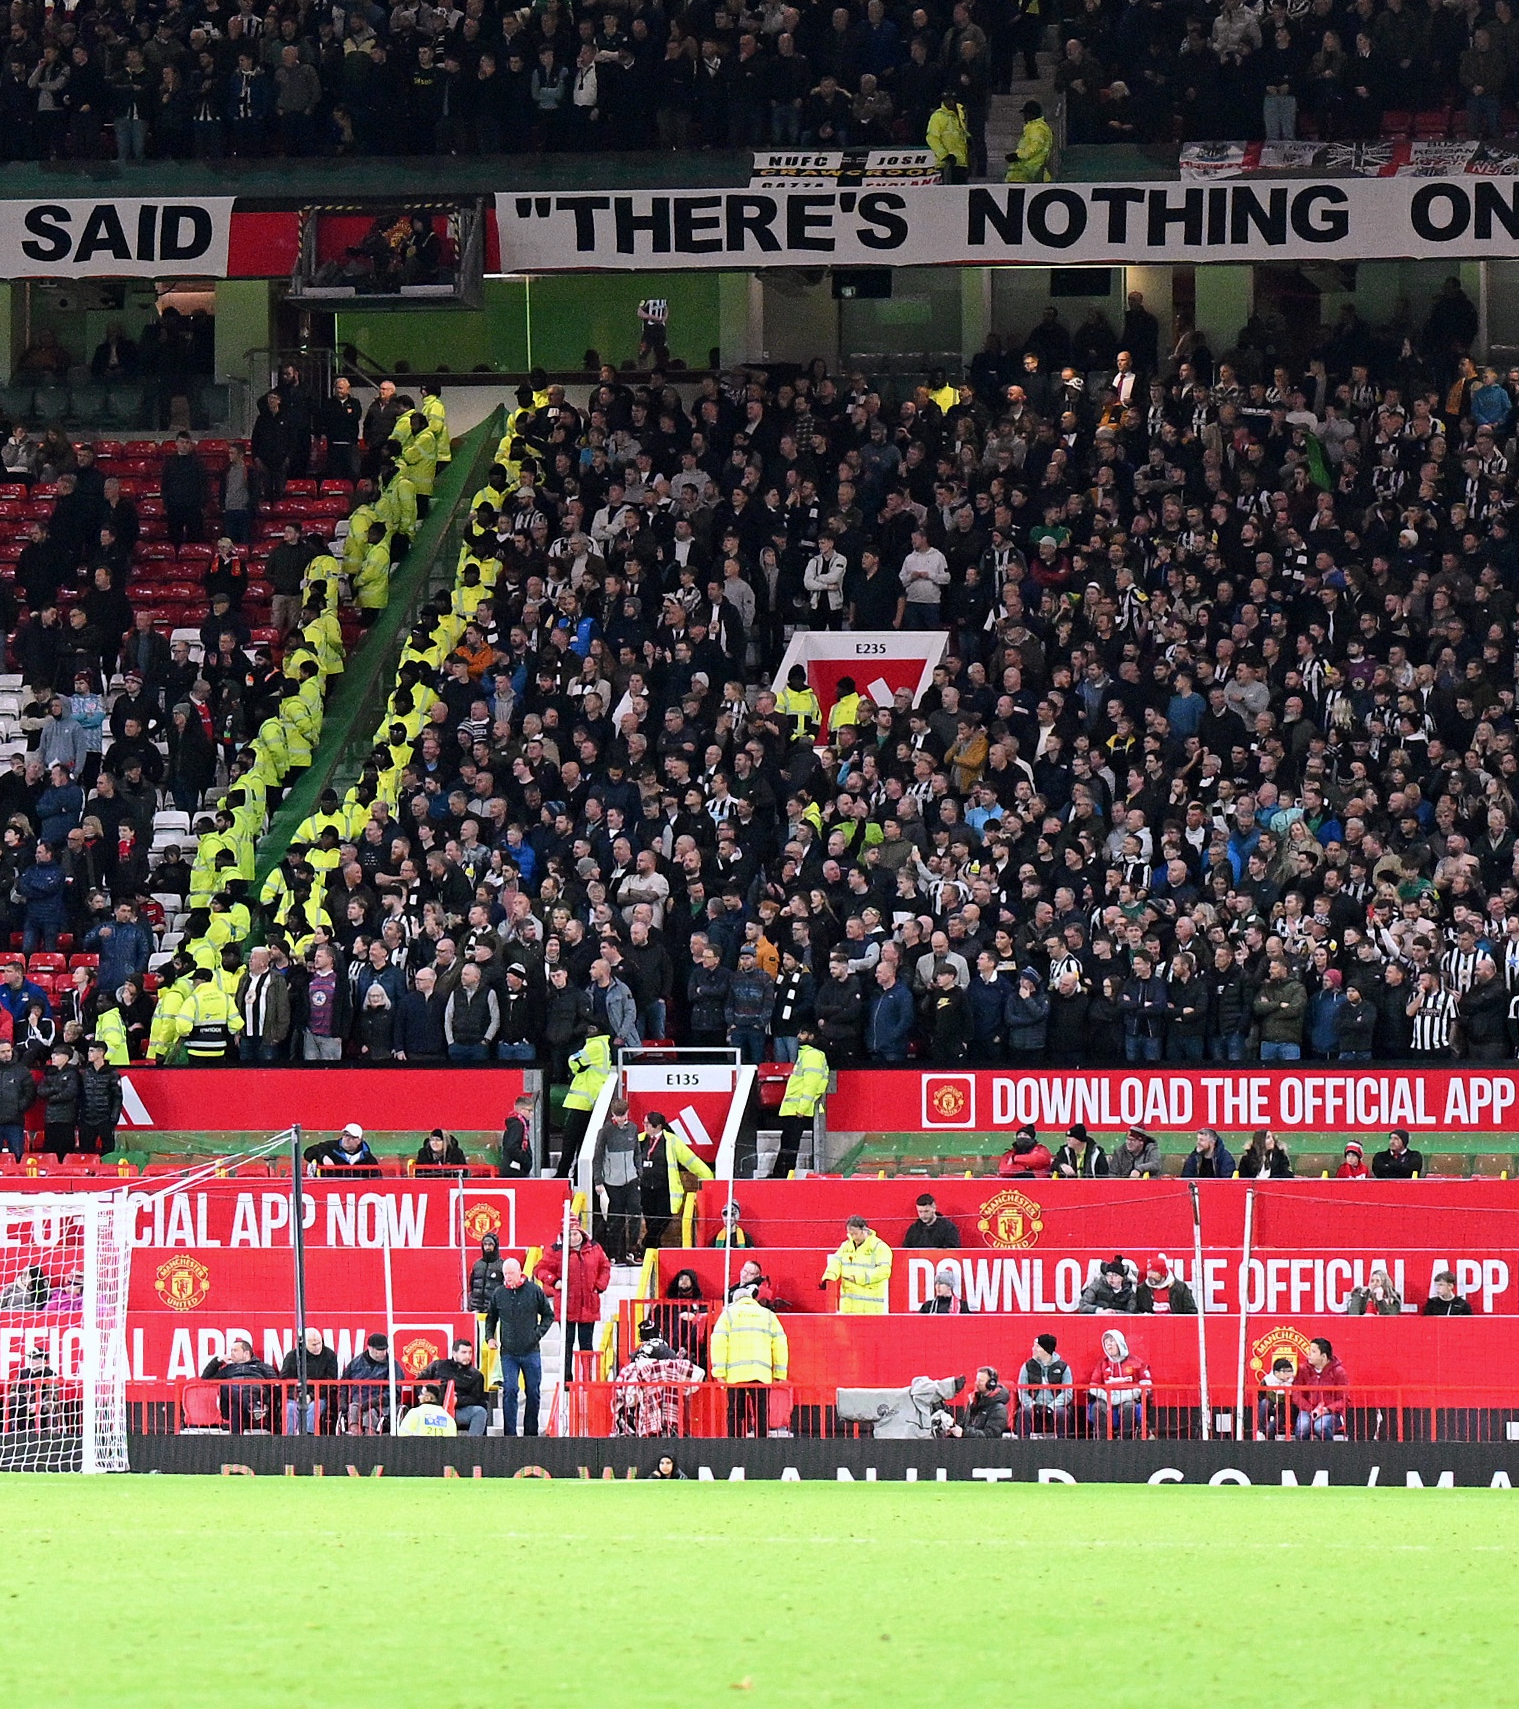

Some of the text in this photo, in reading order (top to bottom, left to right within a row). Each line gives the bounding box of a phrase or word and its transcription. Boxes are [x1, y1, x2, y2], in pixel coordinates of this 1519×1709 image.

[769, 156, 828, 167] NUFC
[876, 155, 927, 166] JOSH
[515, 192, 909, 255] "THERE'S
[967, 183, 1350, 248] NOTHING
[21, 204, 213, 263] SAID
[856, 643, 886, 654] E235
[666, 1074, 699, 1085] E135
[992, 1077, 1193, 1124] DOWNLOAD
[1201, 1077, 1270, 1124] THE
[1279, 1077, 1437, 1124] OFFICIAL
[1444, 1077, 1516, 1124] APP
[984, 1193, 1038, 1216] MANCHESTER
[230, 1192, 316, 1247] APP
[327, 1192, 428, 1247] NOW
[159, 1256, 205, 1279] MANCHESTER
[166, 1295, 198, 1309] UNITED
